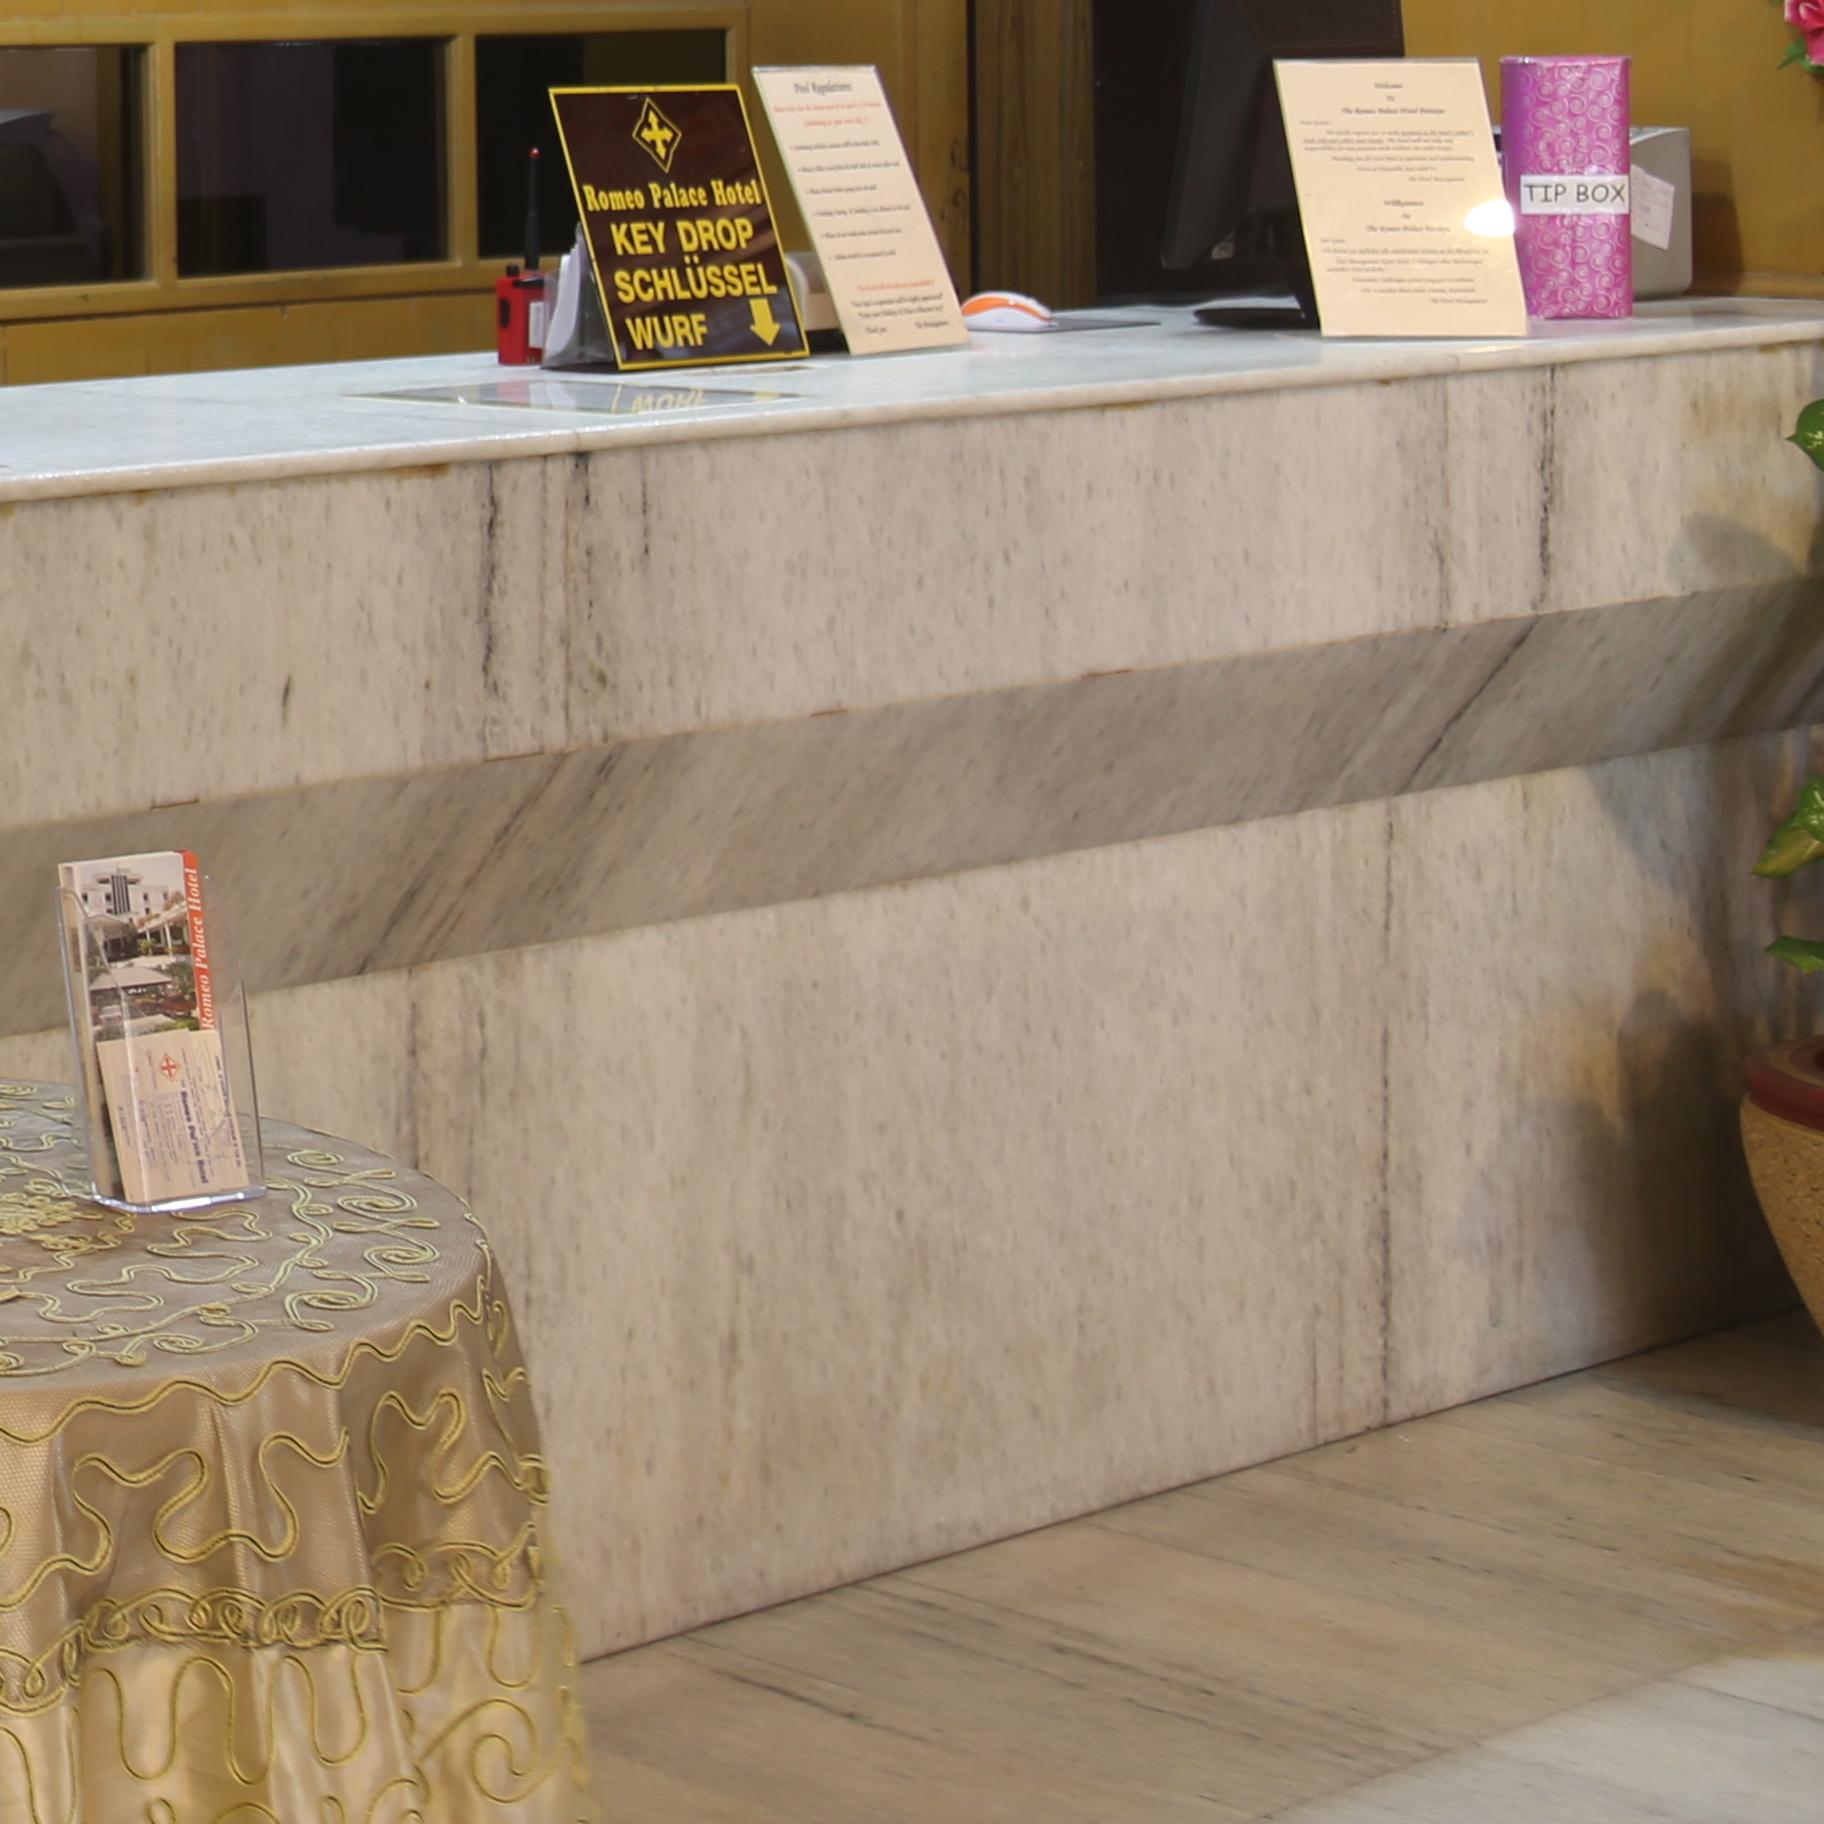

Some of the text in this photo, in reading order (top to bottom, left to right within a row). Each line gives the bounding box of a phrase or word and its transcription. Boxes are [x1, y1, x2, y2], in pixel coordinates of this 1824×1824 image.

[583, 179, 761, 212] Romeo Palace Hotel
[1523, 183, 1625, 203] TIP BOX
[610, 218, 754, 256] KEY DROP
[614, 255, 778, 304] SCHLÜSSEL
[625, 314, 708, 350] WURF
[184, 868, 214, 1029] Romeo Palace Hotel
